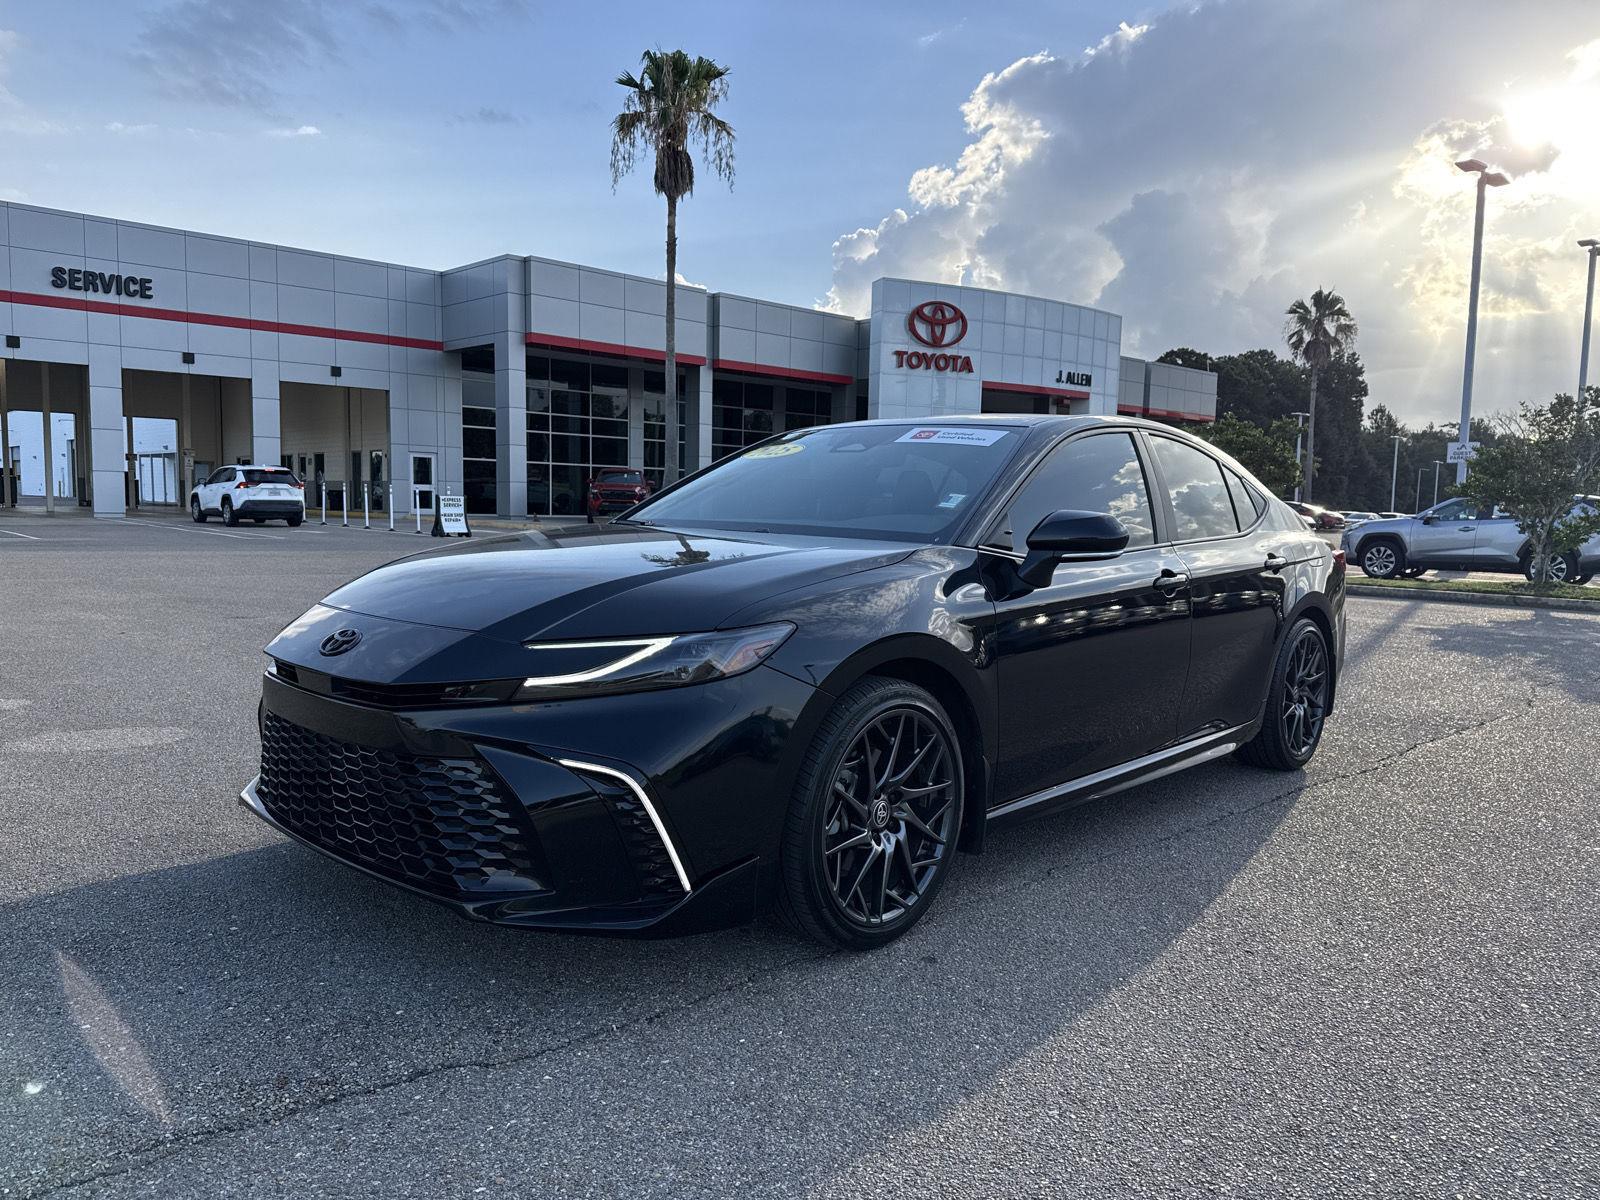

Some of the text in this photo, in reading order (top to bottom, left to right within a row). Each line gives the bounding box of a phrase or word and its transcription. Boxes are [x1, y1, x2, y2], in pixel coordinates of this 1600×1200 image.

[51, 266, 154, 300] SERVICE
[894, 350, 974, 373] TOYOTA
[1056, 370, 1092, 387] J. ALLEN
